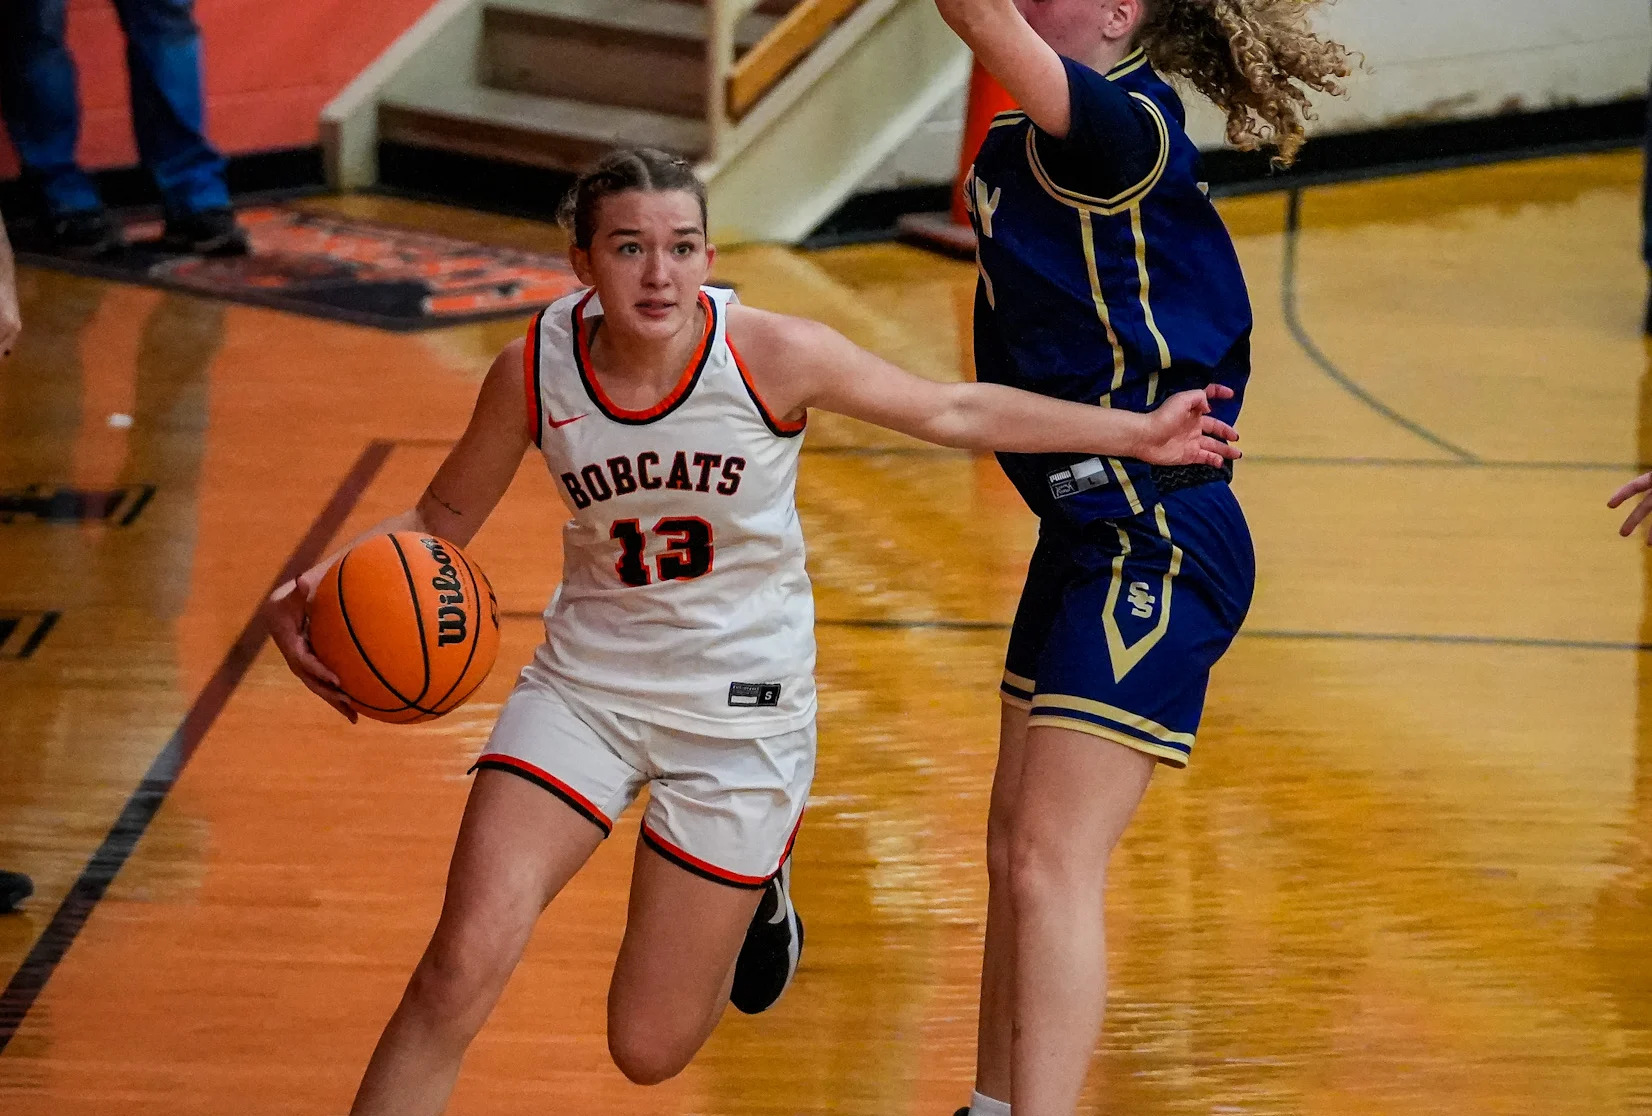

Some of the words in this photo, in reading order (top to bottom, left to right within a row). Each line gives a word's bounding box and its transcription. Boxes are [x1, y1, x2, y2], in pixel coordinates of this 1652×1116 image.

[560, 450, 746, 509] BOBCATS
[609, 516, 715, 587] 13
[420, 537, 467, 647] Wilson
[764, 690, 773, 701] S
